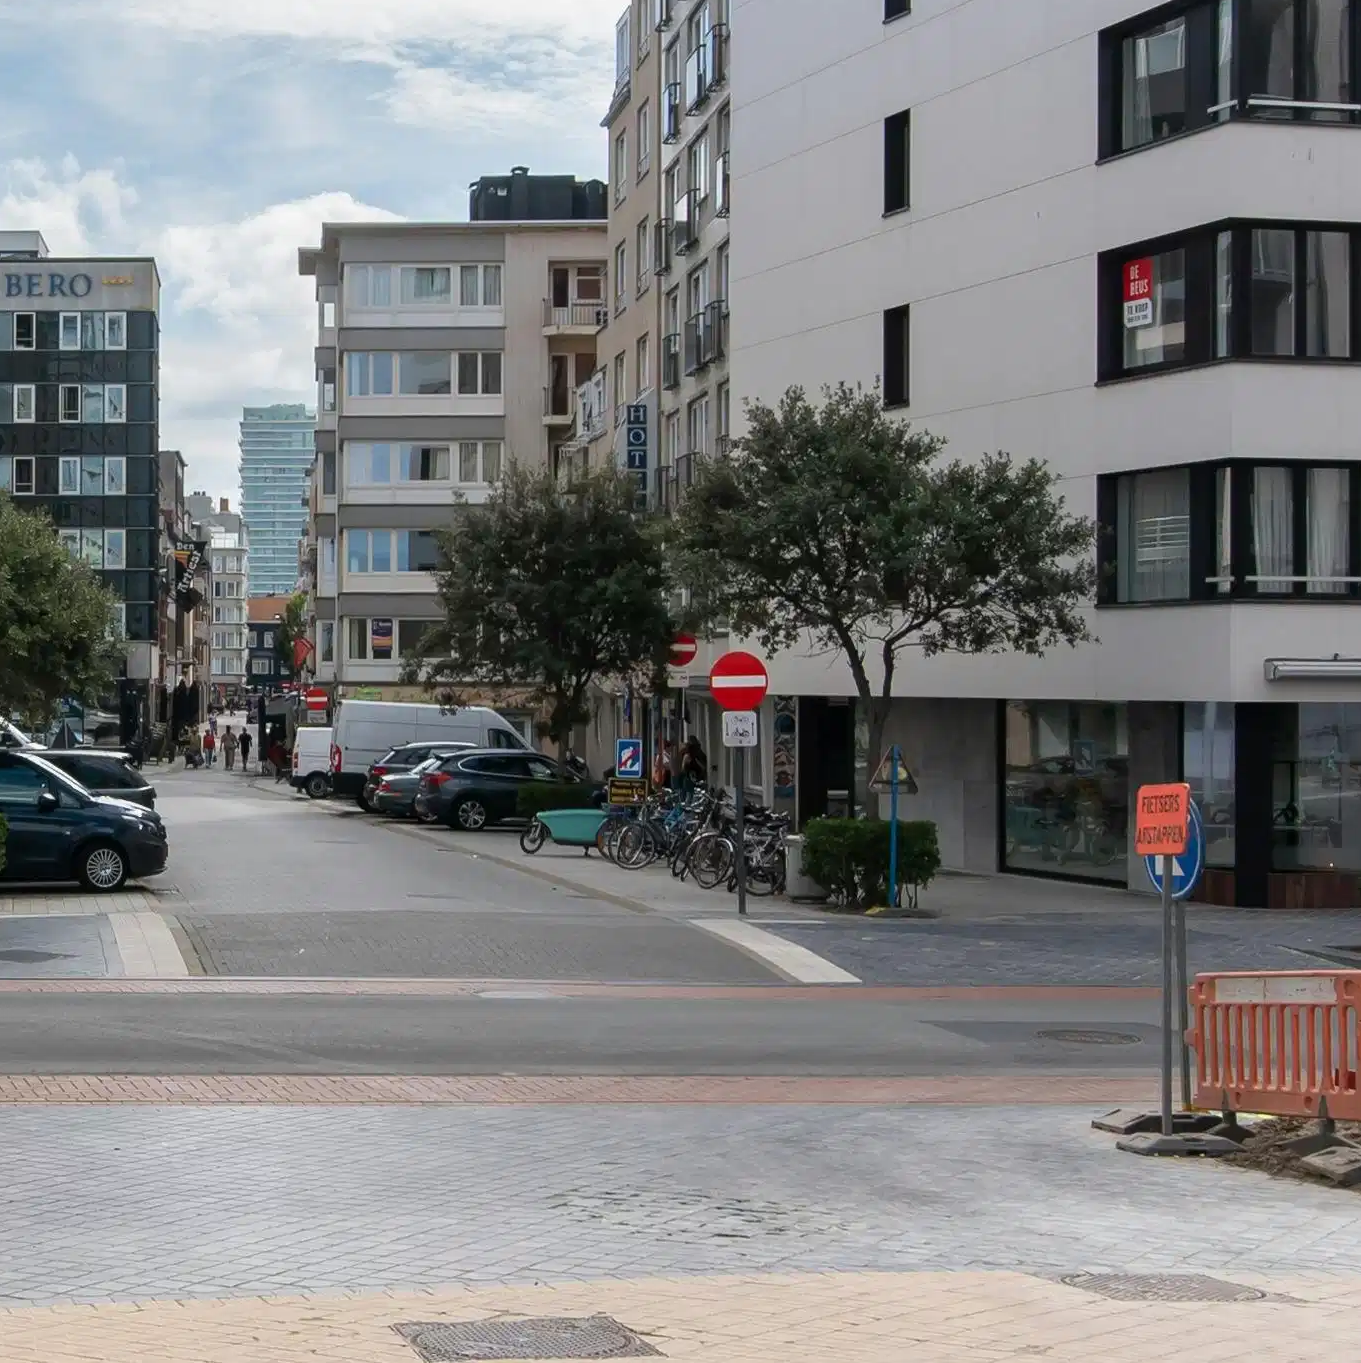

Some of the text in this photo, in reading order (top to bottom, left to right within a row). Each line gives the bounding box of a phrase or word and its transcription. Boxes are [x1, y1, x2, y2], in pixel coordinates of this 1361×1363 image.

[1130, 265, 1139, 280] DE
[5, 272, 93, 298] BERO
[1130, 279, 1148, 296] BEUS
[176, 542, 195, 550] Den
[177, 551, 201, 593] Artiest
[1141, 794, 1180, 814] FIETSERS
[1136, 825, 1184, 845] AFSTAPPEN
